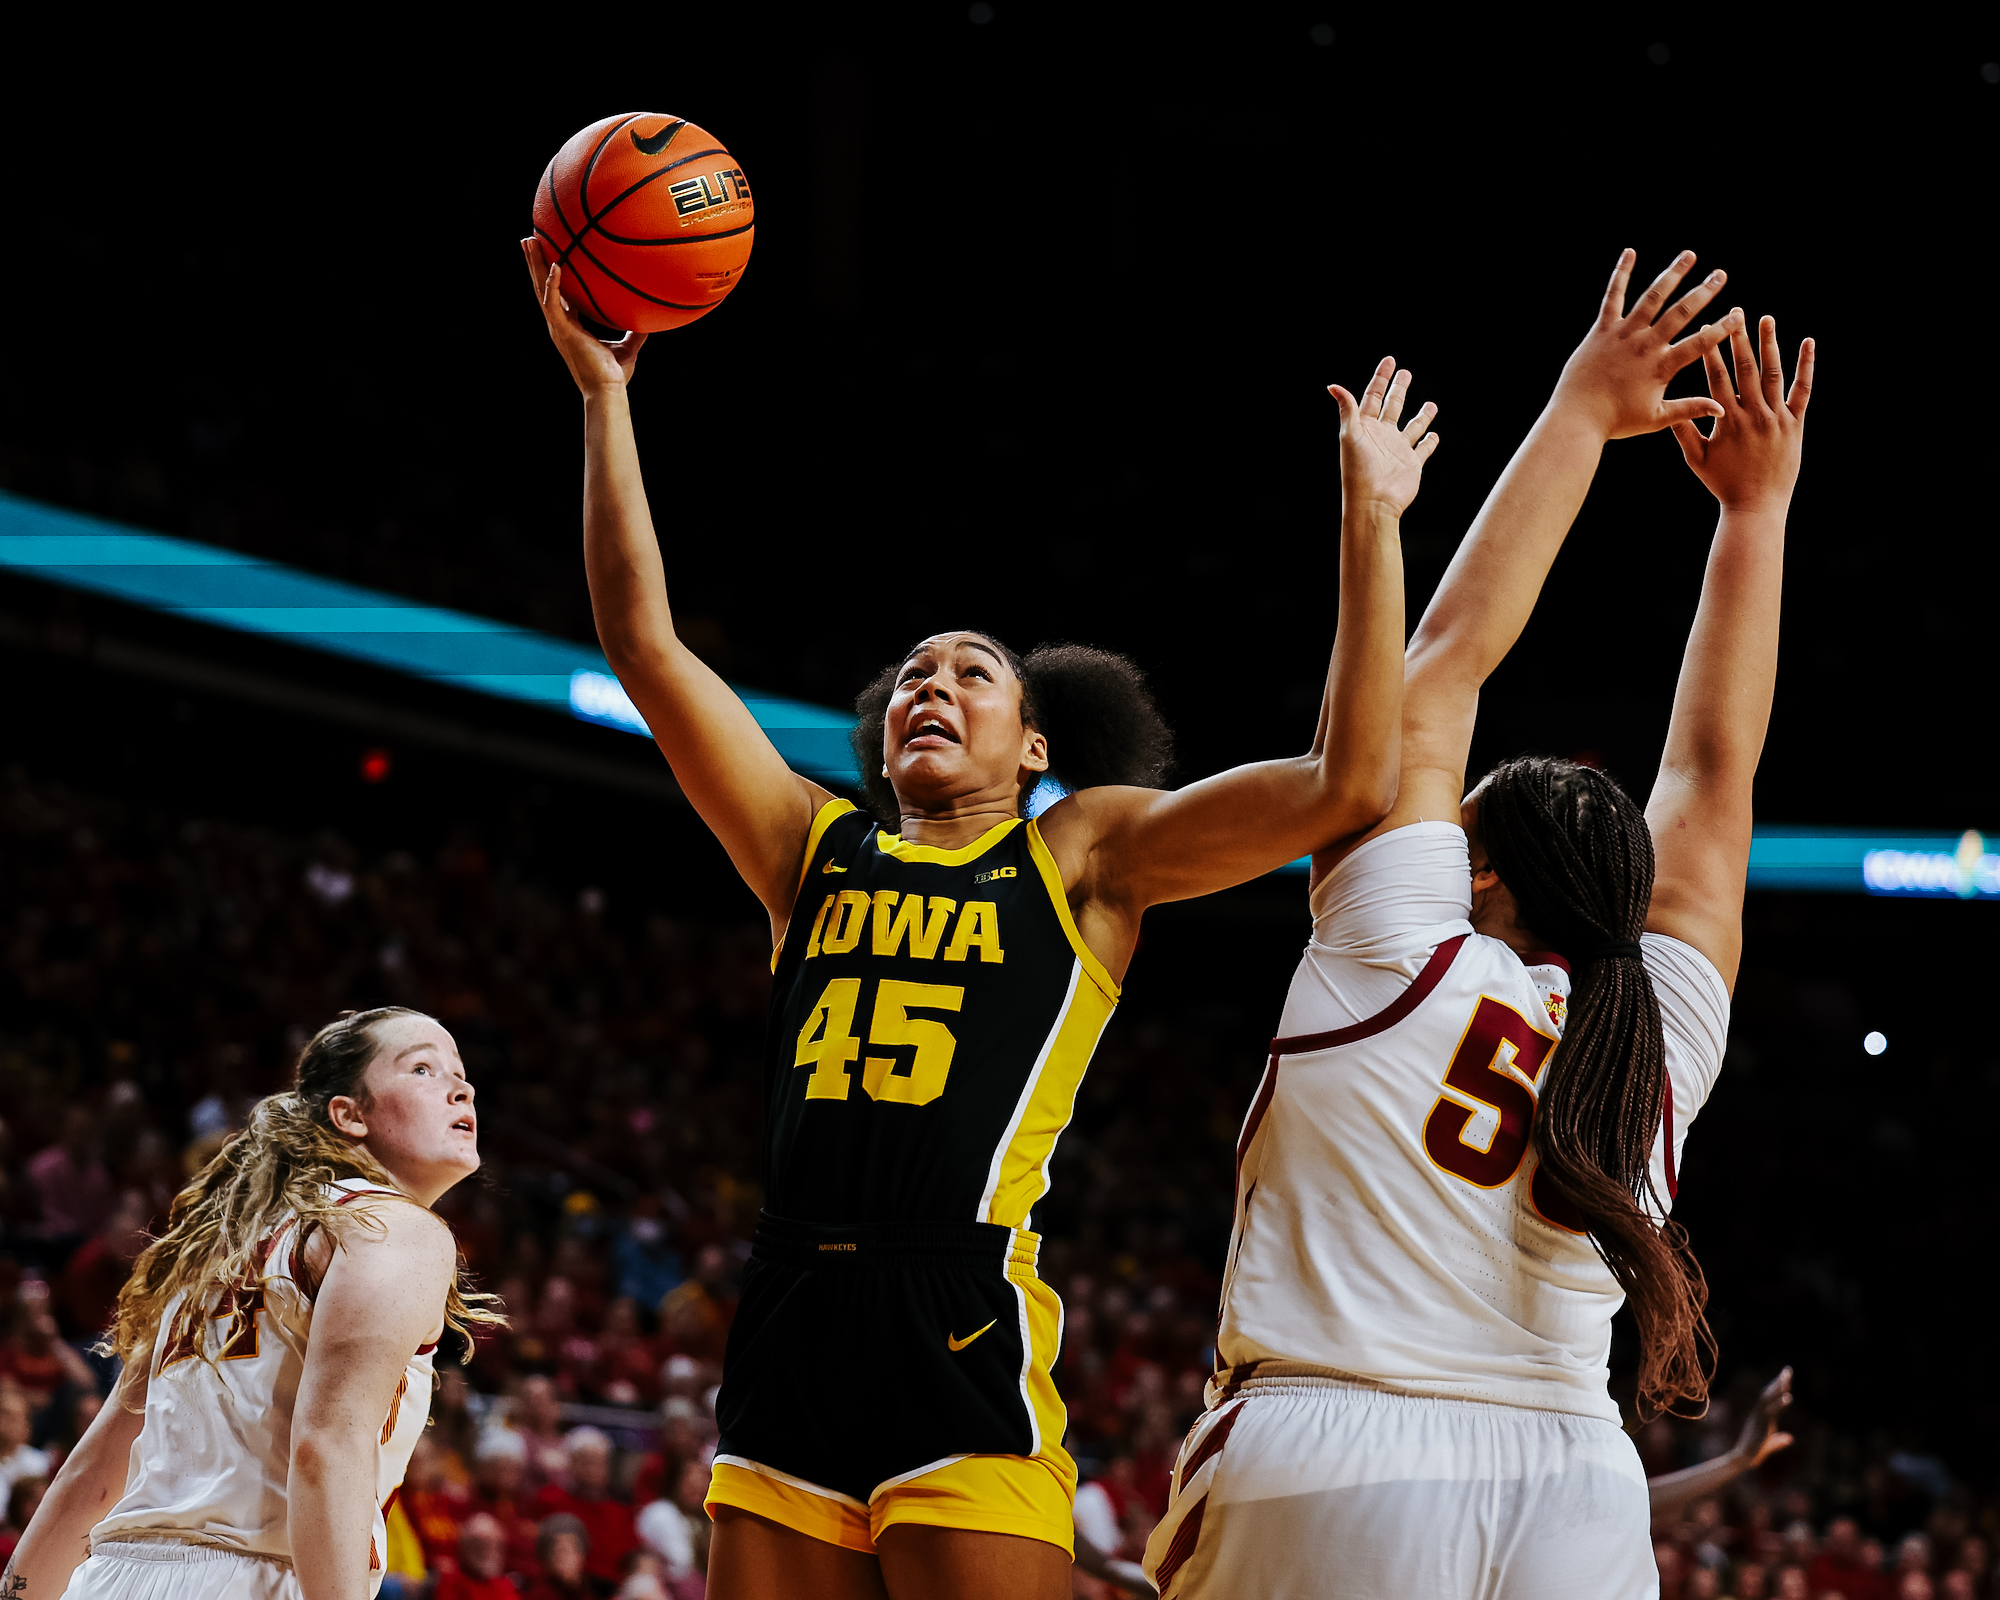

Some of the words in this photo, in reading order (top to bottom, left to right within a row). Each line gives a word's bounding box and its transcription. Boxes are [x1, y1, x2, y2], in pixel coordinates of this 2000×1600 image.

[668, 168, 751, 218] ELITE
[805, 889, 1005, 964] IOWA
[794, 977, 965, 1107] 45
[1422, 994, 1588, 1236] 5
[818, 1243, 857, 1251] HAWKEYES
